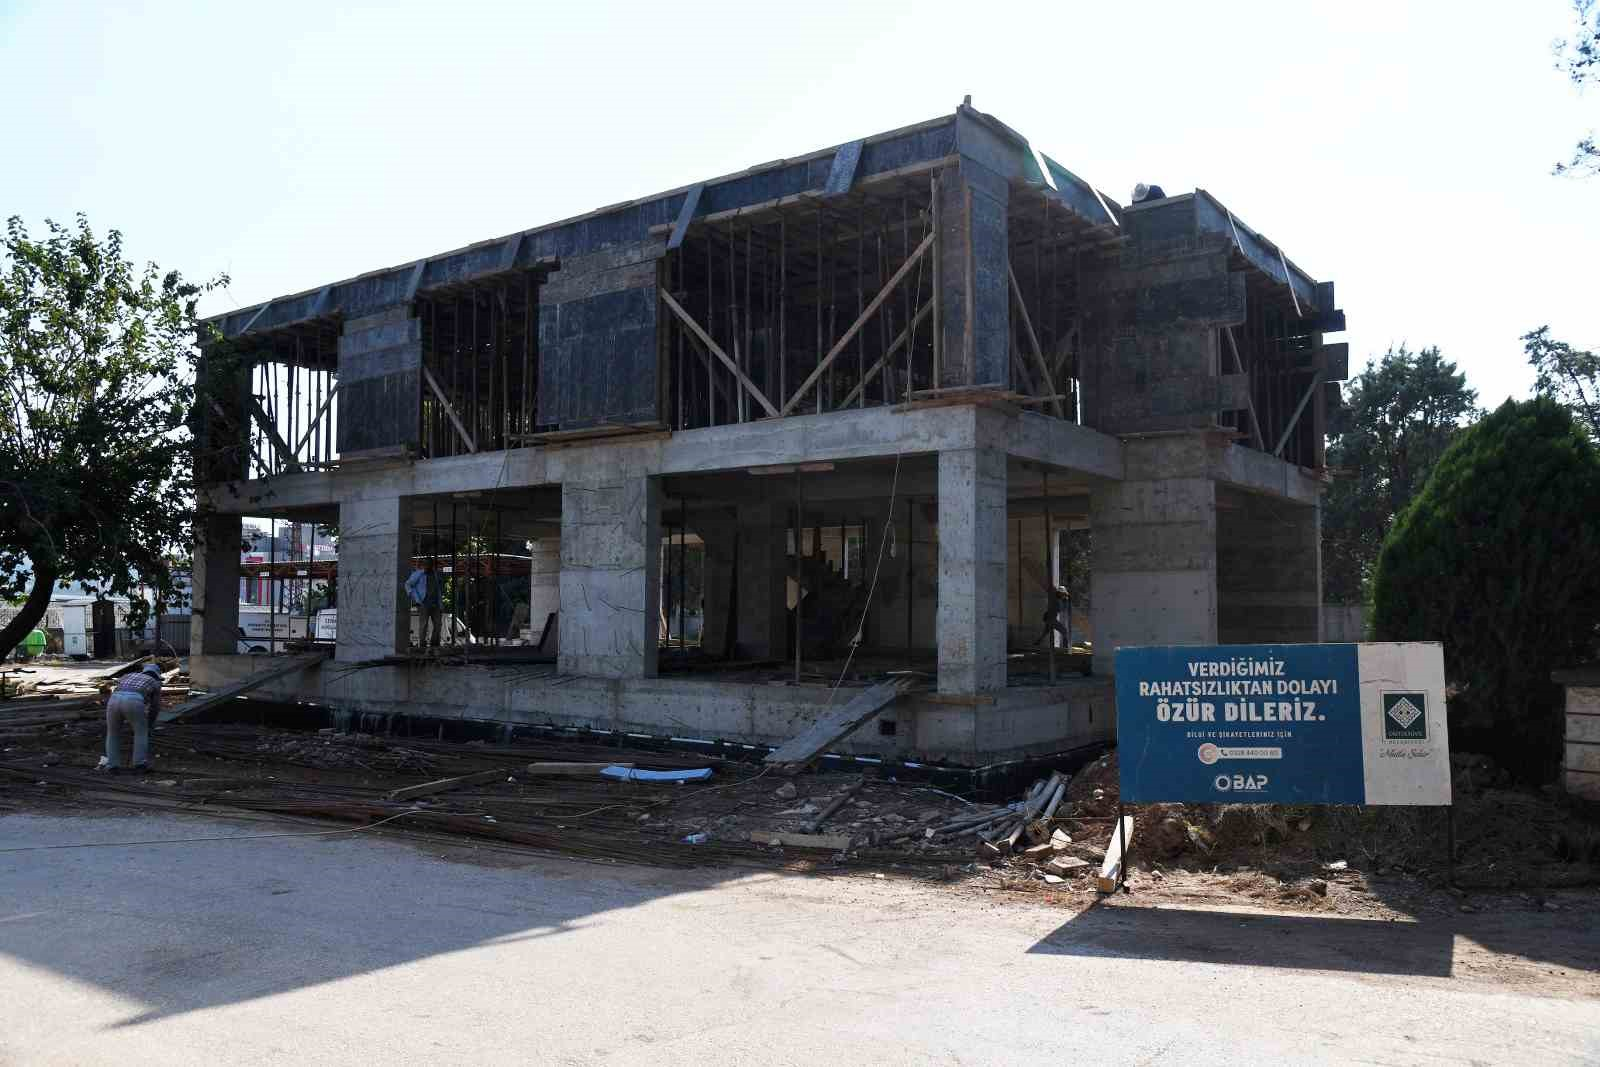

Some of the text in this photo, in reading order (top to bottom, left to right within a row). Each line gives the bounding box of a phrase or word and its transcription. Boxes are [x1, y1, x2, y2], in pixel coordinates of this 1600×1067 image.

[1187, 657, 1285, 676] VERDİĞİMİZ
[1139, 679, 1337, 696] RAHATSIZLIKTAN DOLAYI
[1156, 696, 1326, 722] ÖZÜR DİLERİZ.
